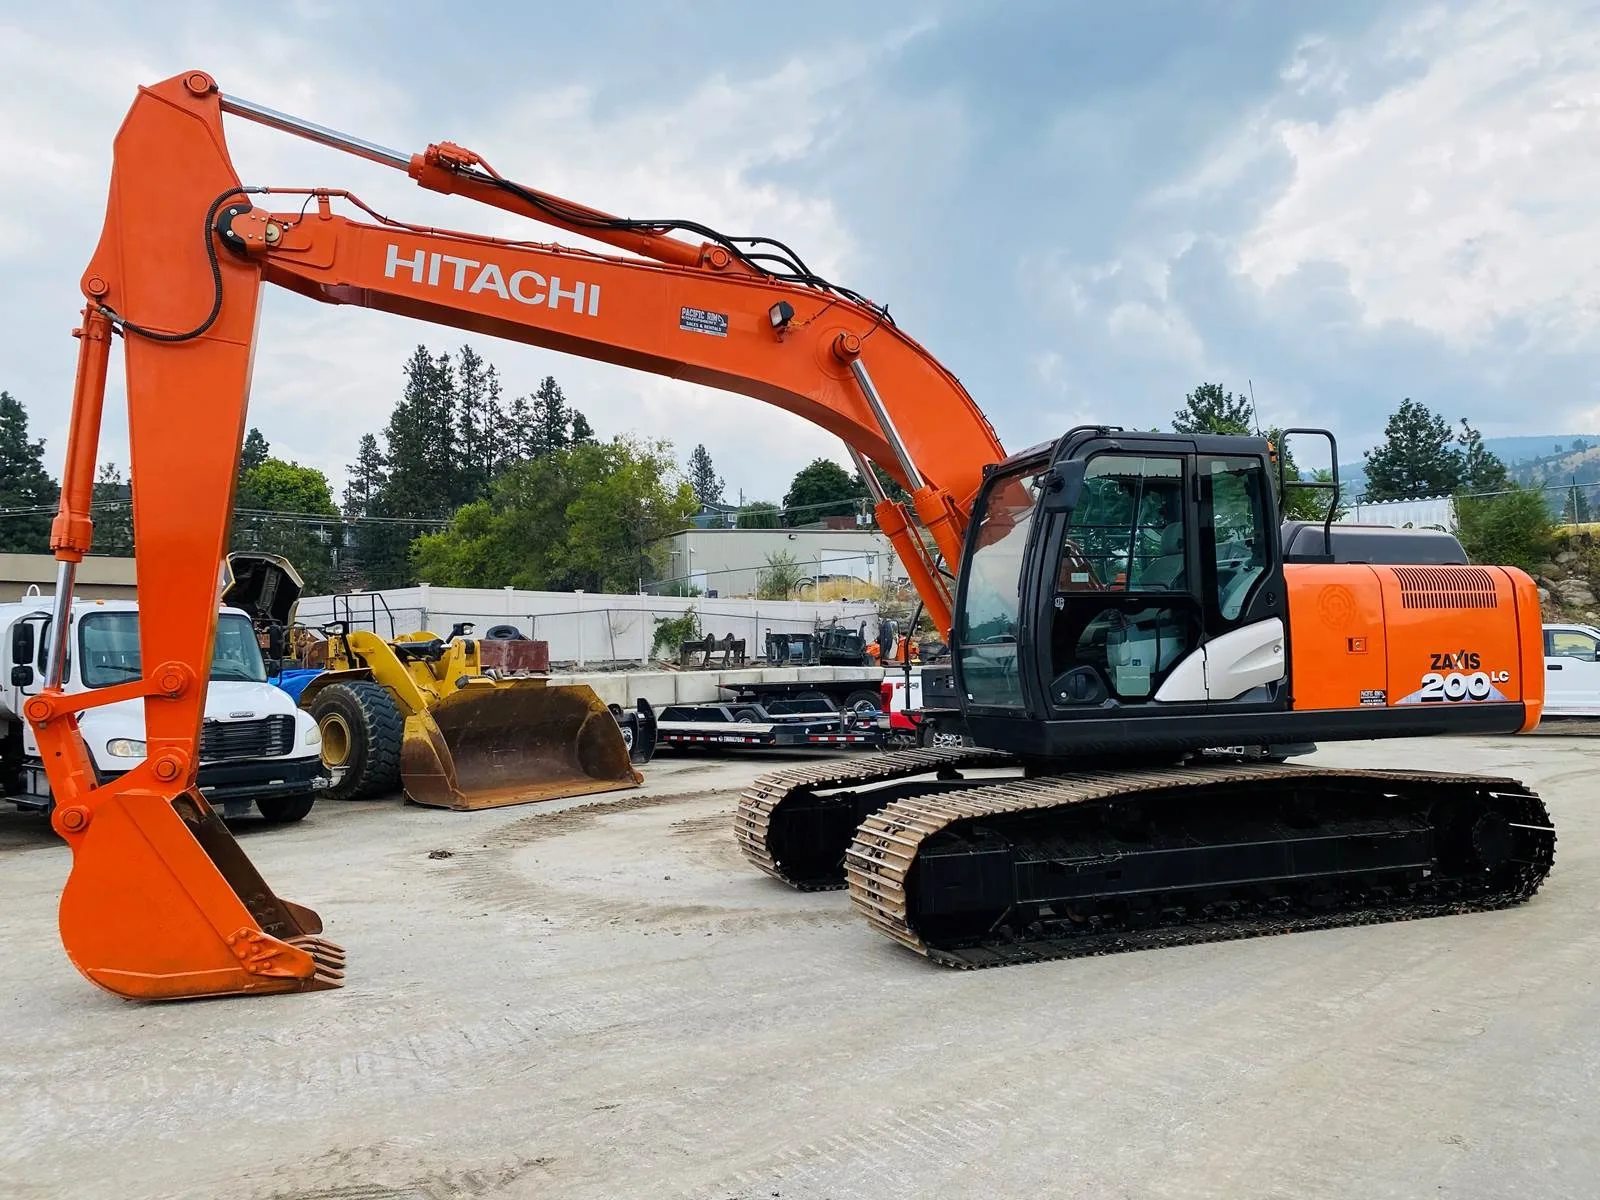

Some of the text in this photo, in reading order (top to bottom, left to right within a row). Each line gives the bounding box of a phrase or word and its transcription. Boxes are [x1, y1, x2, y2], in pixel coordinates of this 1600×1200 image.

[384, 243, 600, 317] HITACHI
[681, 307, 705, 319] PACIFIC
[1430, 649, 1481, 671] ZAXIS
[1420, 670, 1510, 702] 200 LC
